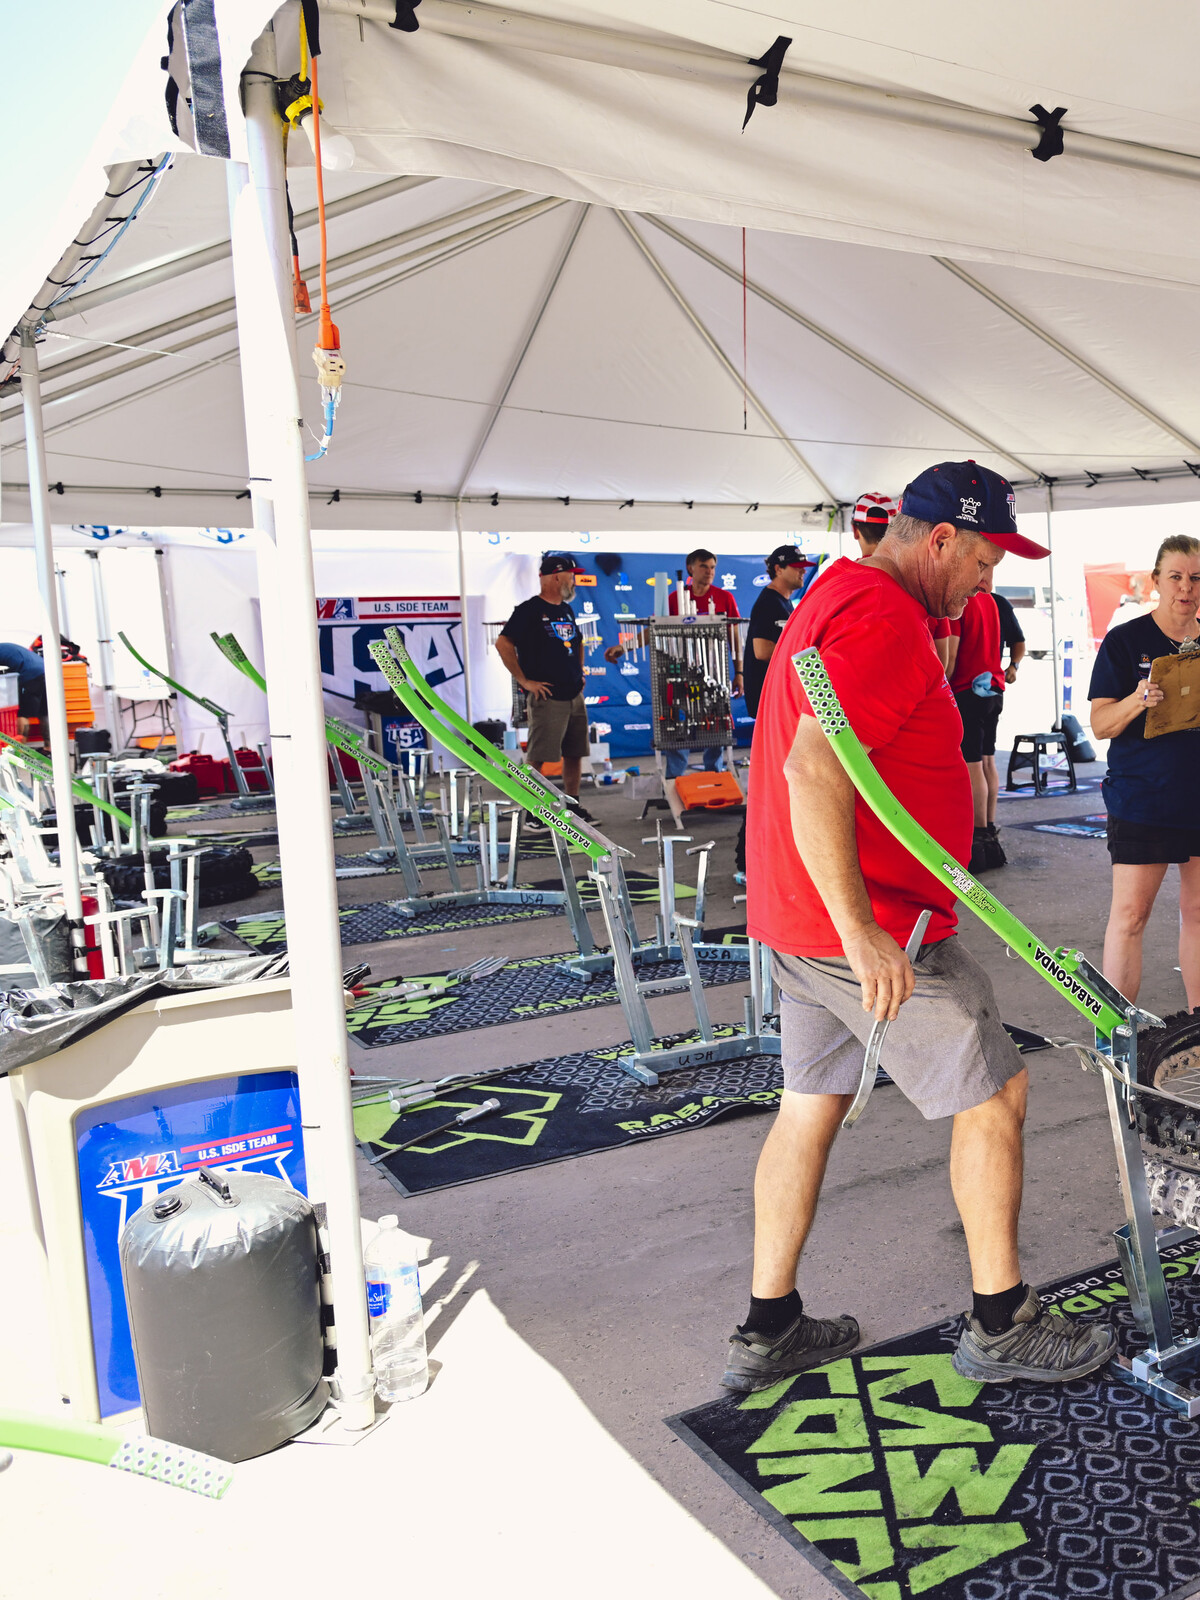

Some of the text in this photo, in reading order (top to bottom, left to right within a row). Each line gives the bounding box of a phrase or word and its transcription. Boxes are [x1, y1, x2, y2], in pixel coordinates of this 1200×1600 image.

[374, 602, 449, 613] U.S. ISDE TEAM
[386, 727, 425, 748] USA
[340, 740, 378, 769] RABACONDA
[507, 761, 546, 797] RABACONDA
[538, 804, 591, 849] RABACONDA
[520, 892, 544, 905] USA
[697, 949, 731, 960] USA
[1034, 945, 1103, 1017] RABACONDA
[198, 1134, 277, 1161] U.S. ISDE TEAM
[96, 1150, 182, 1189] AMA
